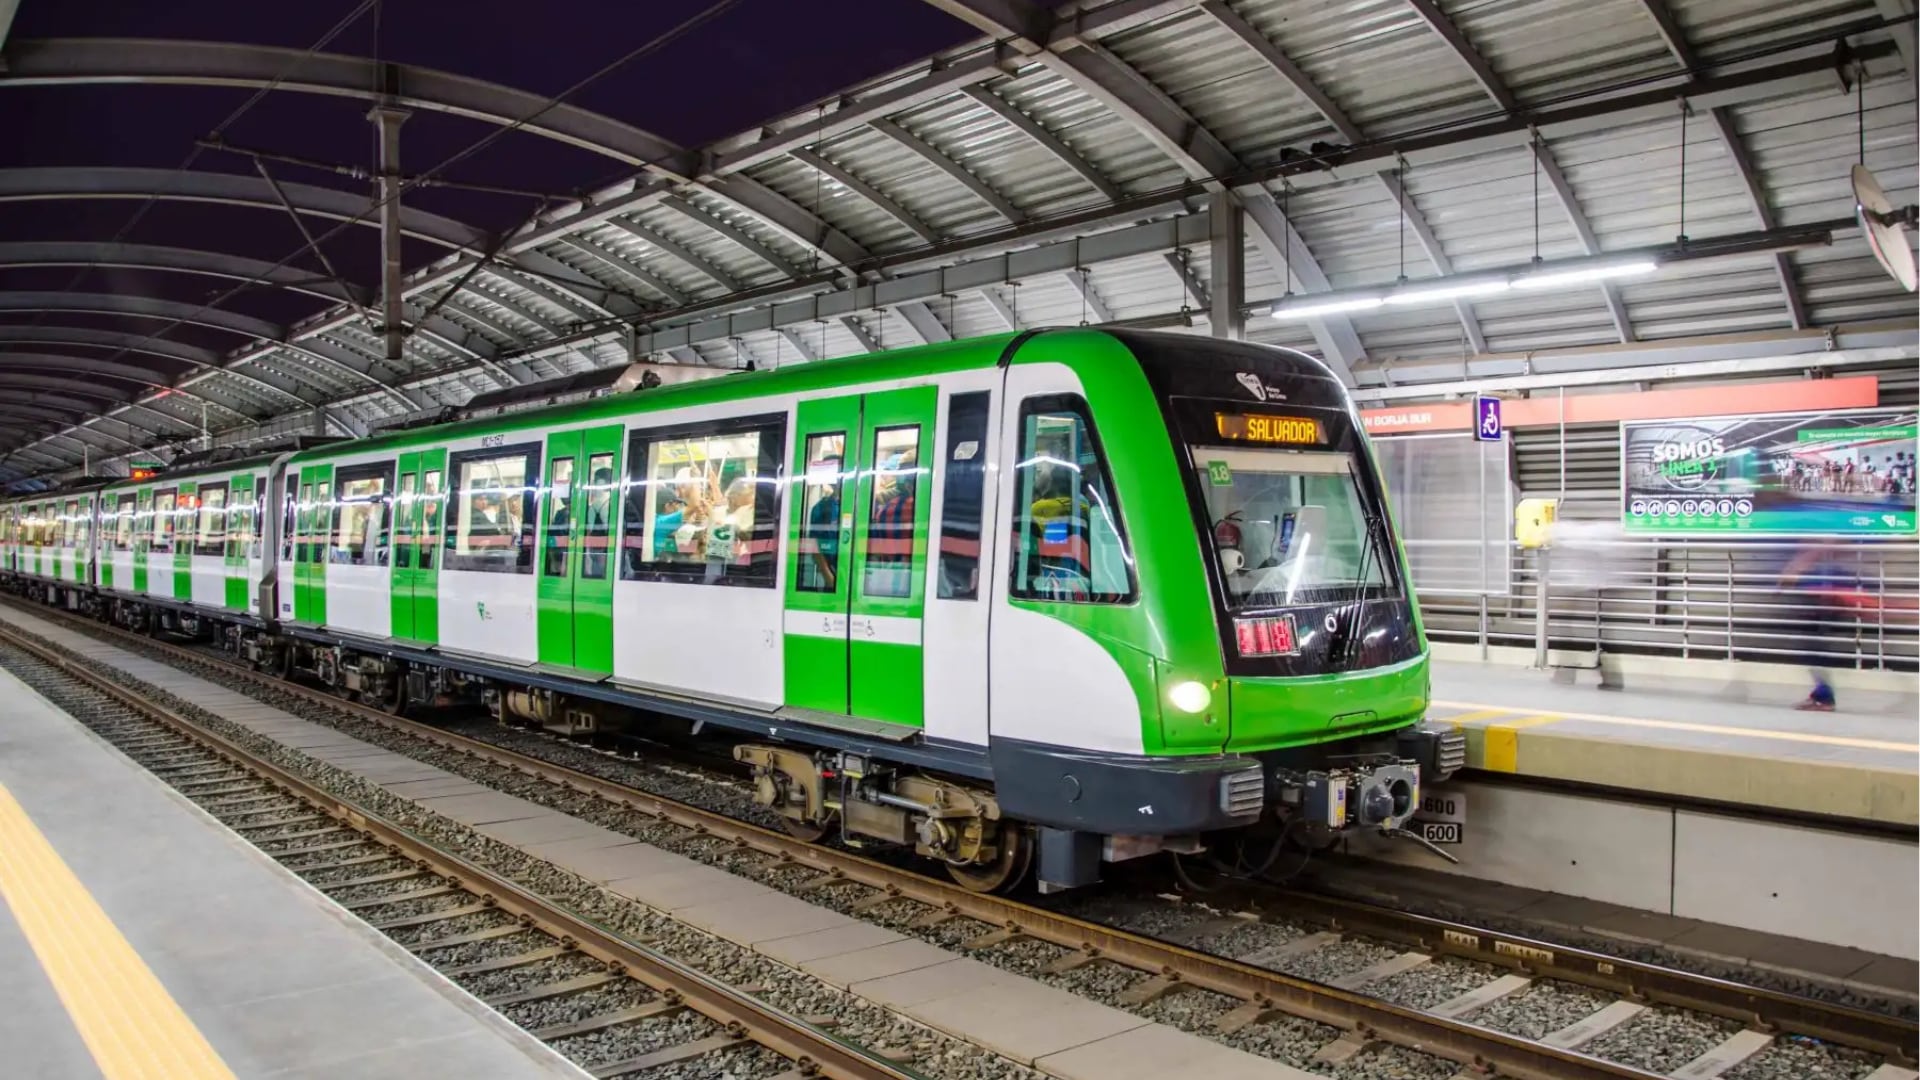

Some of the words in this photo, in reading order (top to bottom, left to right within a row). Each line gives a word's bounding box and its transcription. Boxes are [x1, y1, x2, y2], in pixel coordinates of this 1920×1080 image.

[1374, 414, 1409, 426] BORJA
[1248, 418, 1315, 443] SALVADOR
[1653, 437, 1724, 463] SOMOS
[1707, 457, 1716, 472] 1
[1211, 465, 1229, 481] 18
[1424, 797, 1456, 815] 600
[1426, 825, 1456, 841] 600
